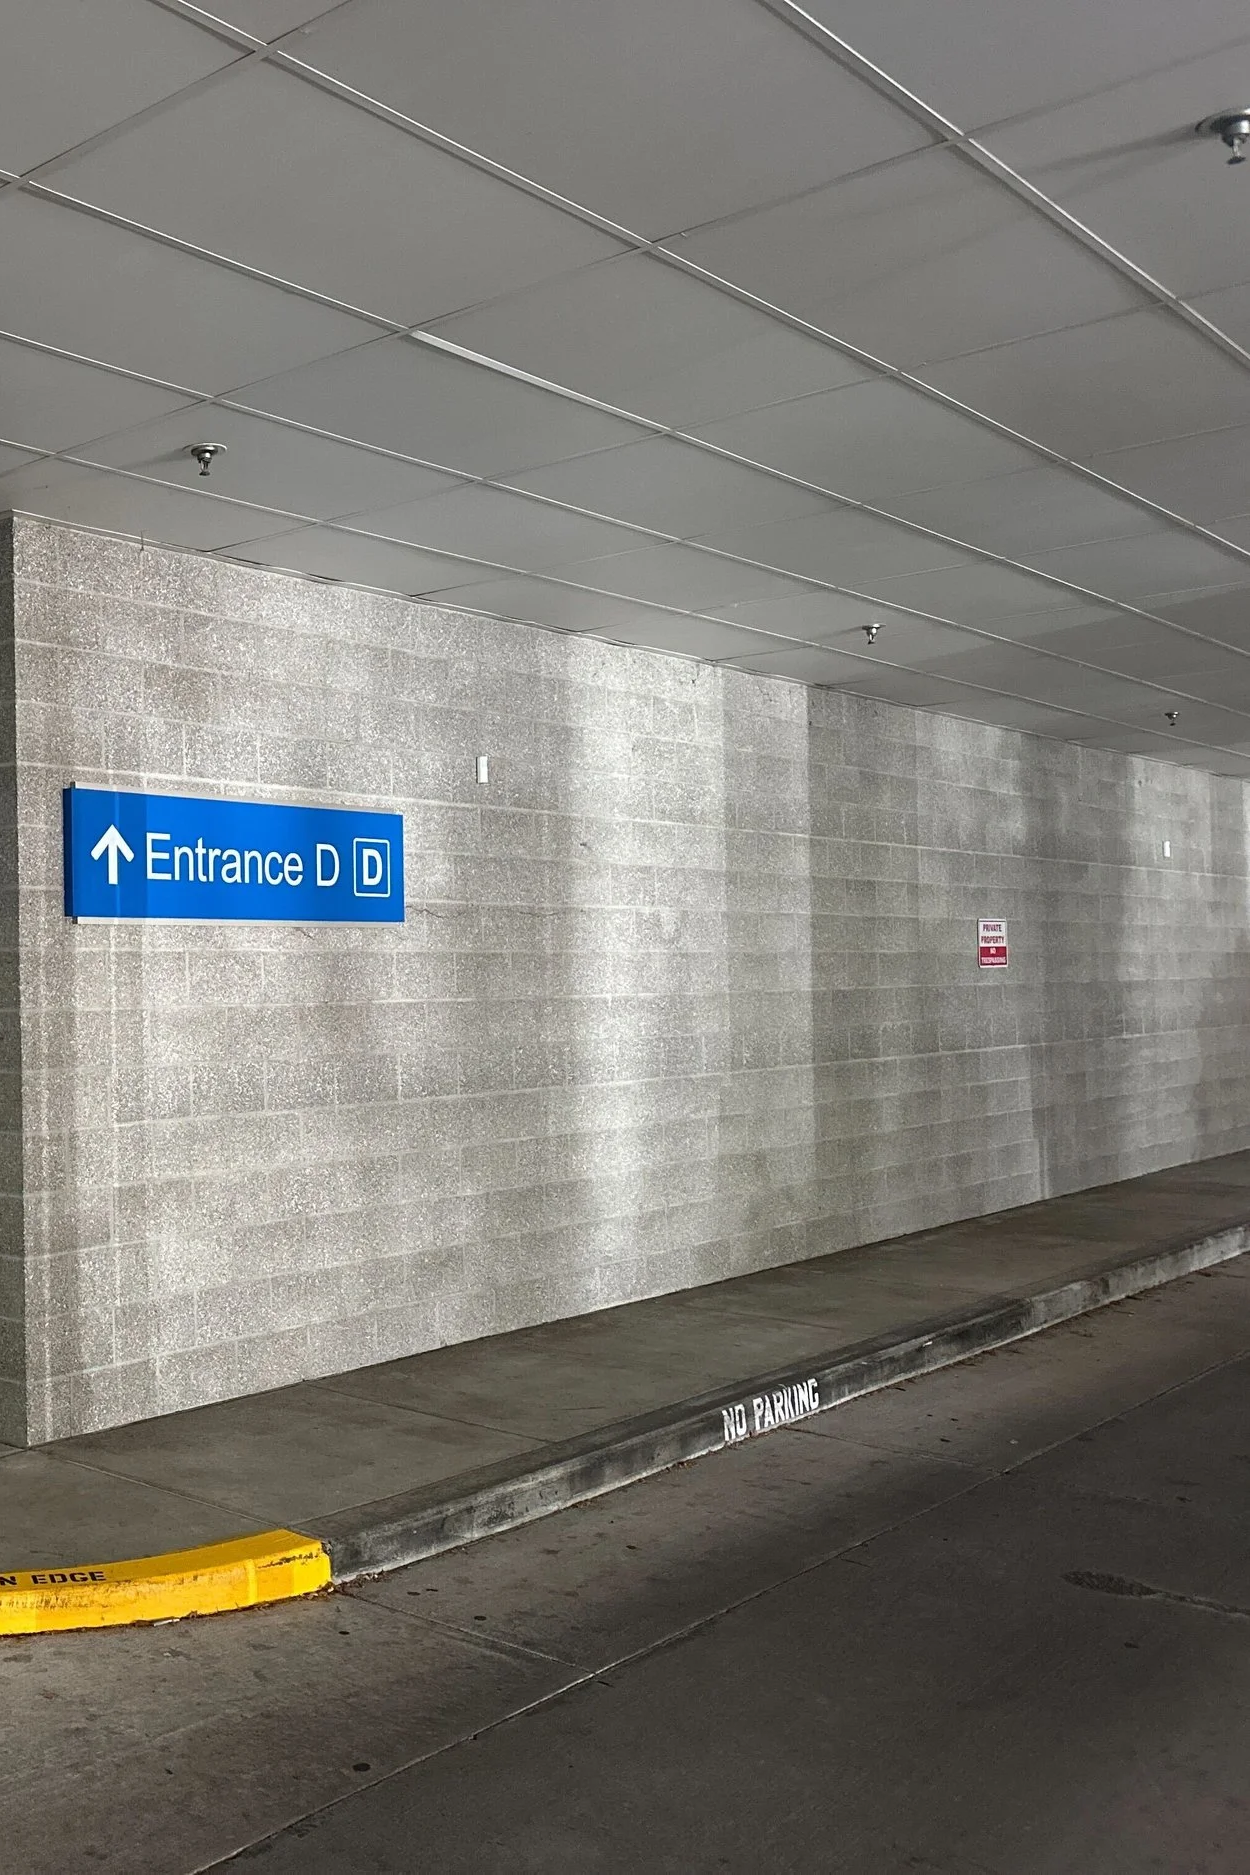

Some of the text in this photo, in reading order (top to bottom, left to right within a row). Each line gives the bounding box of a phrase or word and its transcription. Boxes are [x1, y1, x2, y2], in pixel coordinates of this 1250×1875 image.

[146, 832, 383, 887] Entrance D D
[983, 924, 1002, 932] PRIVATE
[981, 936, 1004, 944] PROPERTY
[722, 1378, 819, 1441] NO PARKING
[31, 1571, 107, 1585] EDGE
